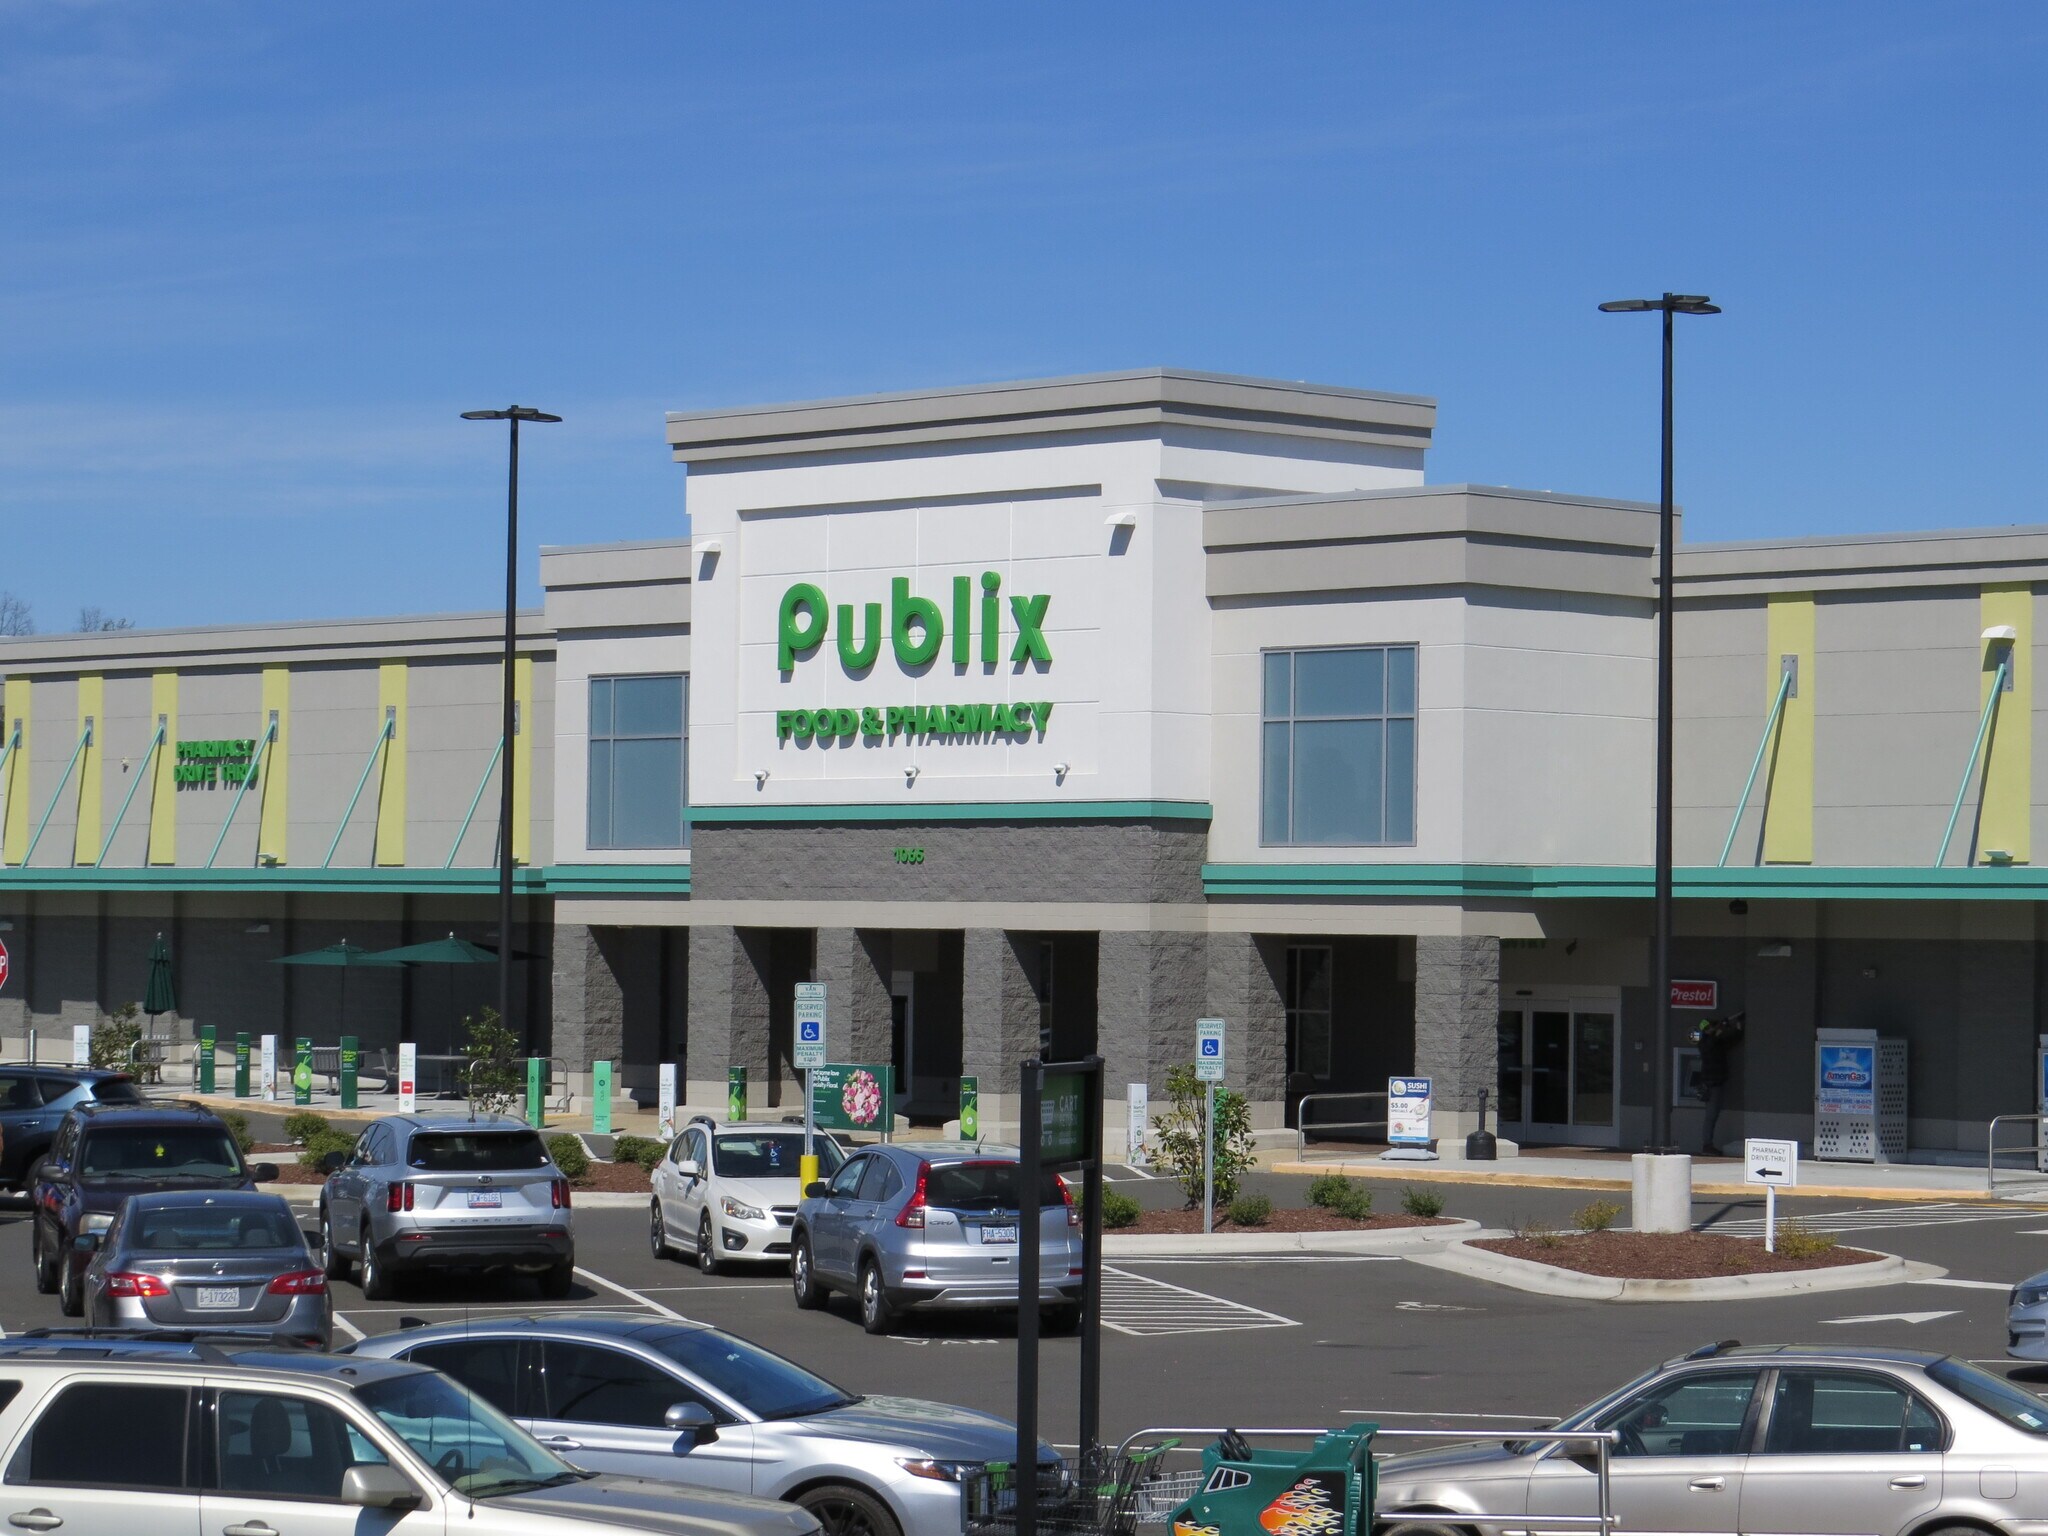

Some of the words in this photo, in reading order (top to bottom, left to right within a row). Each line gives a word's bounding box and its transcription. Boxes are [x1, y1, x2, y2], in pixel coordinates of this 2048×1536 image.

[777, 571, 1053, 671] Publix
[776, 708, 859, 738] FOOD
[860, 706, 885, 736] &
[886, 702, 1054, 735] PHARMACY
[176, 739, 256, 758] PHARMACY
[174, 765, 217, 782] DRIVE
[1671, 988, 1712, 1001] Presto!
[1826, 1071, 1867, 1081] AmeriGas
[1060, 1095, 1078, 1112] CART
[1751, 1154, 1787, 1162] DRIVE-THRU
[1752, 1146, 1786, 1155] PHARMACY
